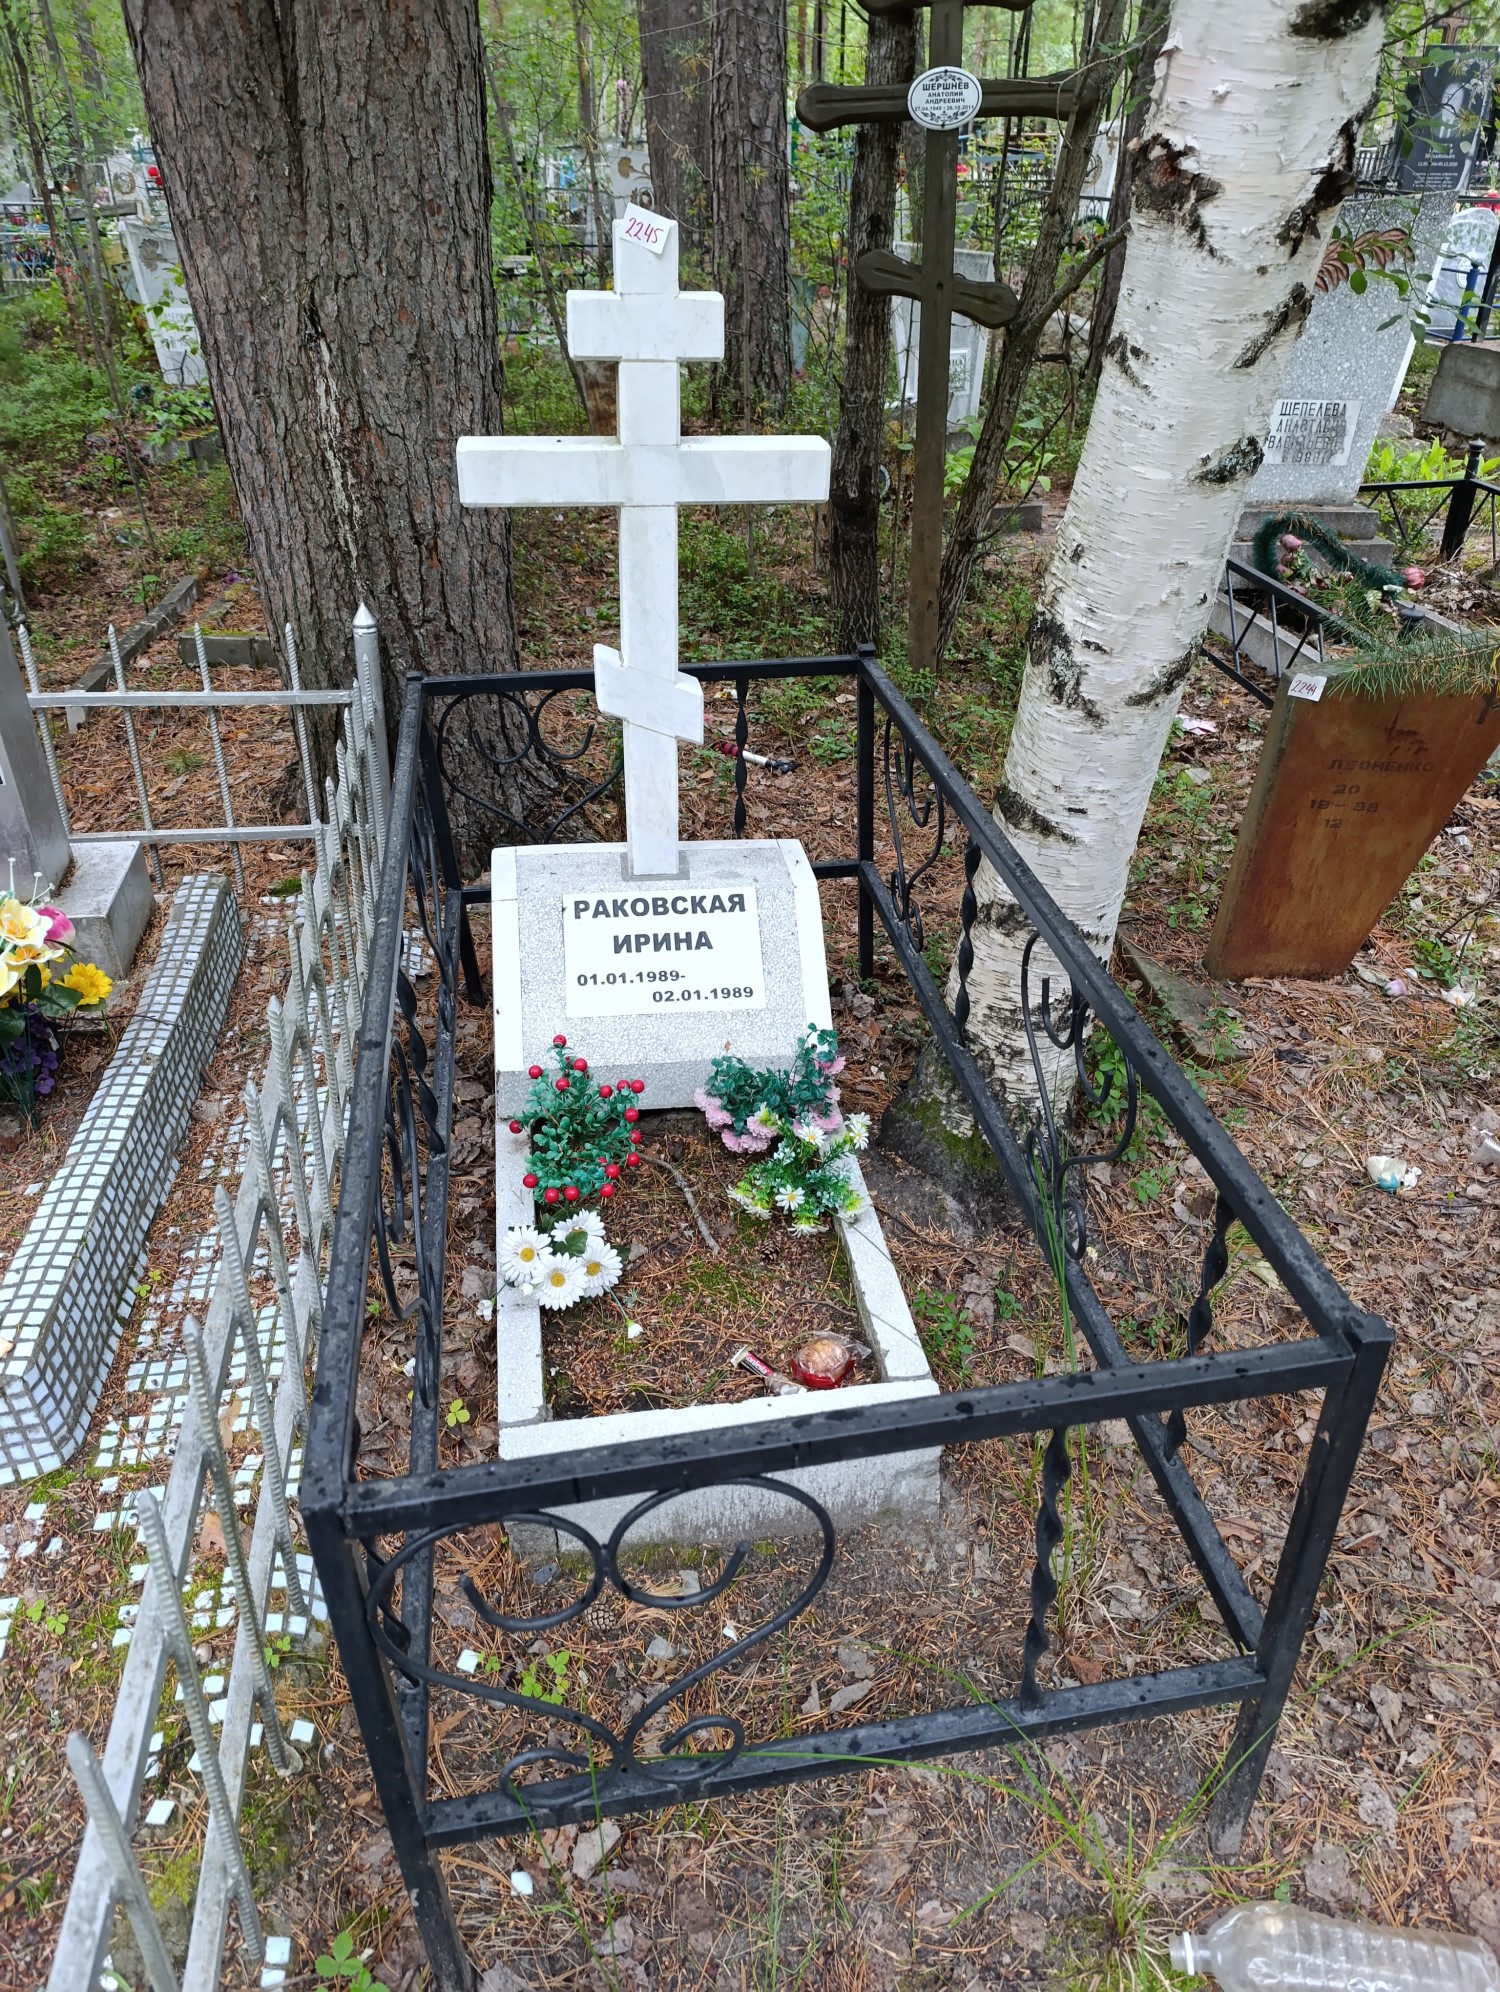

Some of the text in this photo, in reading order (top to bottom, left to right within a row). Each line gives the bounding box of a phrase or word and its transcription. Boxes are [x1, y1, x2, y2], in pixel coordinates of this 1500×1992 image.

[625, 217, 664, 244] 2245
[1279, 402, 1347, 417] ШЕПЕЛЕВА
[1328, 759, 1435, 773] ЛЕОНЕНКО
[1333, 784, 1361, 795] 20
[1324, 819, 1343, 829] 12
[574, 894, 746, 920] РАКОВСКАЯ
[613, 931, 714, 954] ИРИНА
[577, 970, 686, 986] 01.01.1989-
[652, 986, 754, 1003] 02.01.1989
